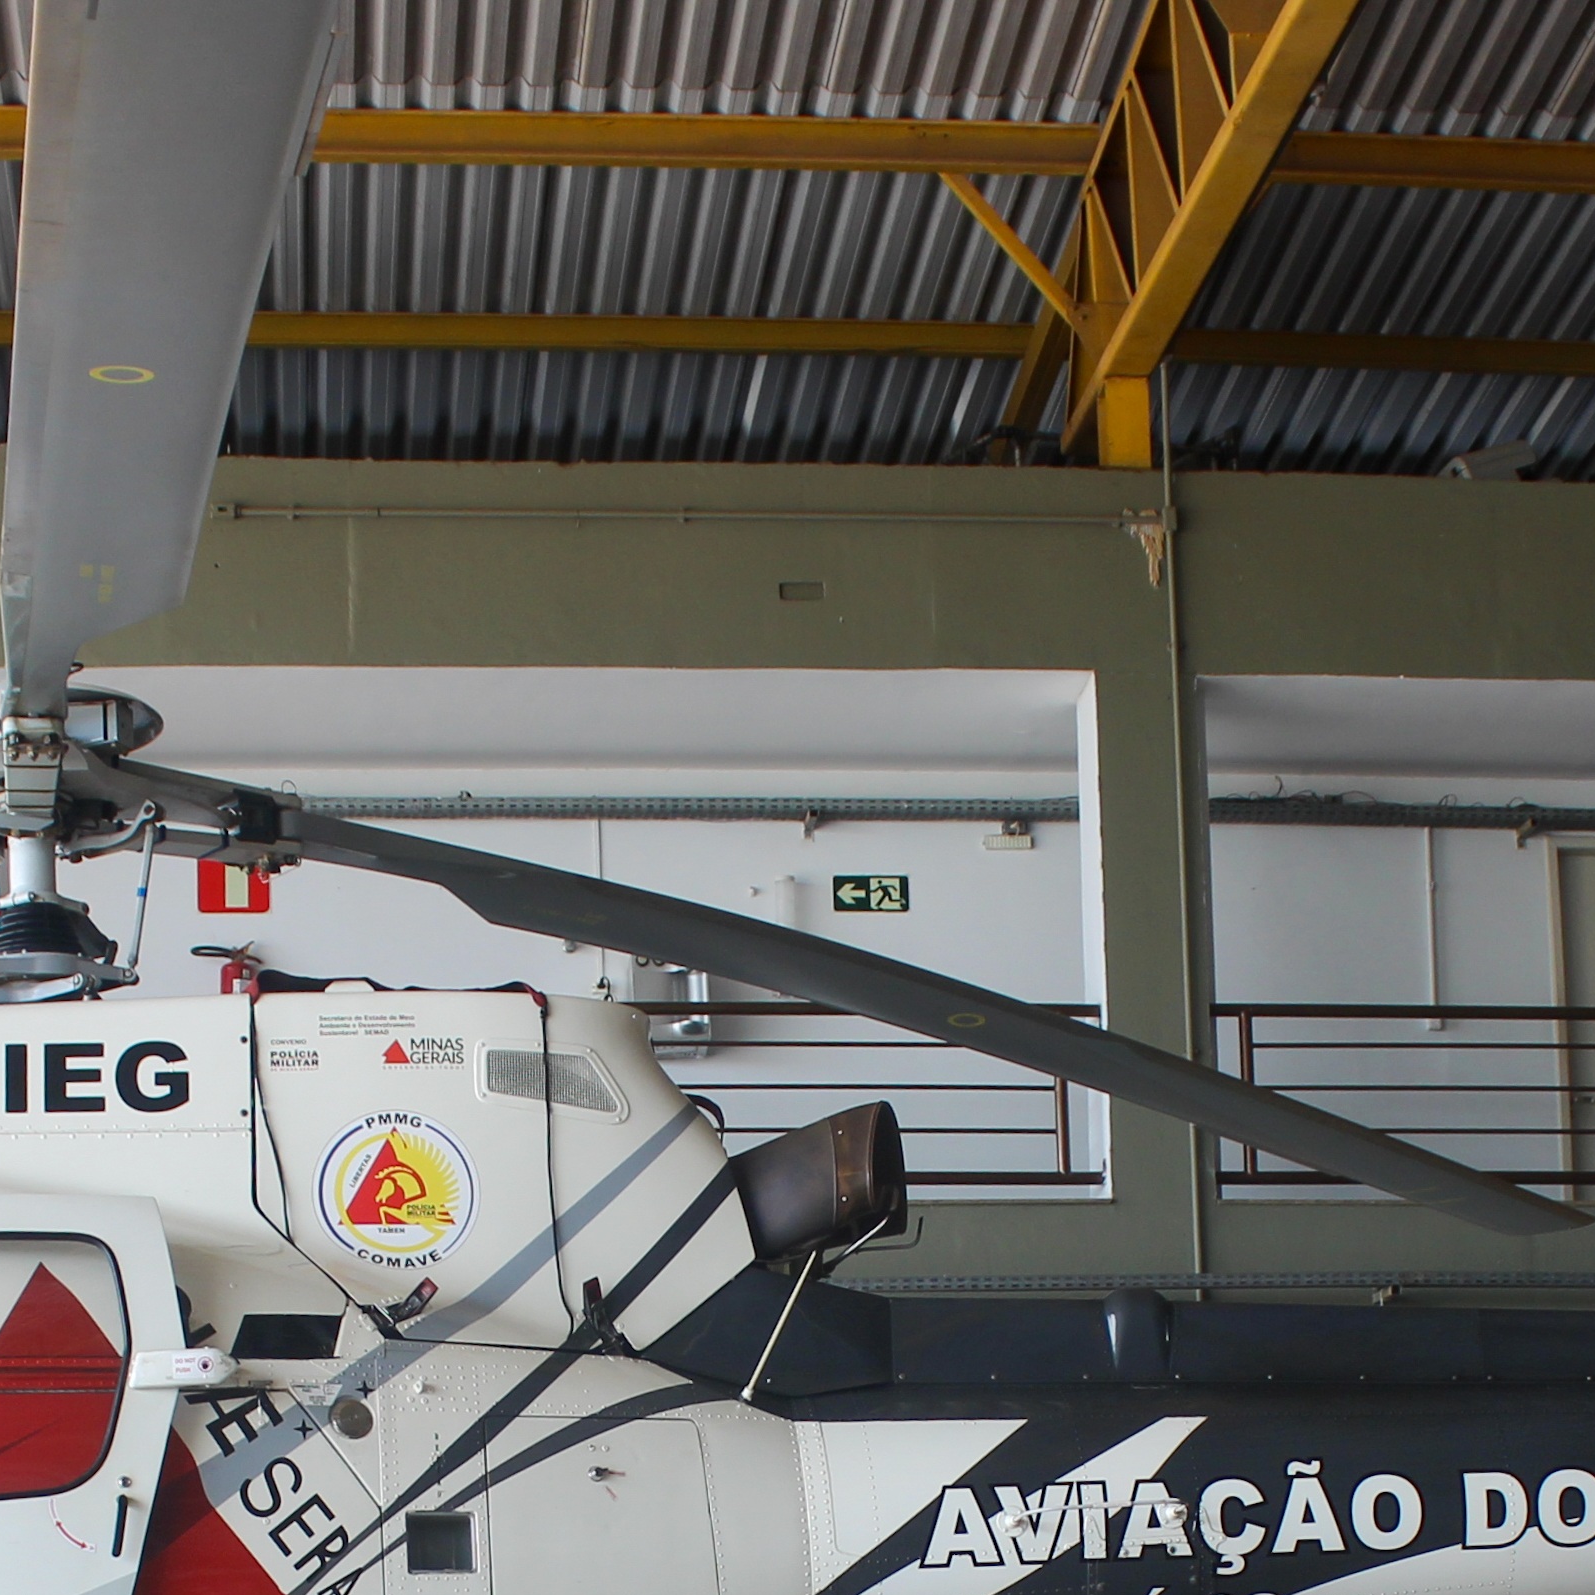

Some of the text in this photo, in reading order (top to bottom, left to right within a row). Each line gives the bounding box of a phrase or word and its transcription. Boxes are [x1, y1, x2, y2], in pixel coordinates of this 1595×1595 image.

[410, 1038, 464, 1050] MINAS
[270, 1049, 319, 1058] POLÍCIA
[410, 1052, 465, 1064] GERAIS
[270, 1059, 319, 1067] MILITAR
[365, 1112, 422, 1129] PMMG
[357, 1249, 442, 1269] COMAVE
[920, 1458, 1425, 1579] AVIAÇÃO
